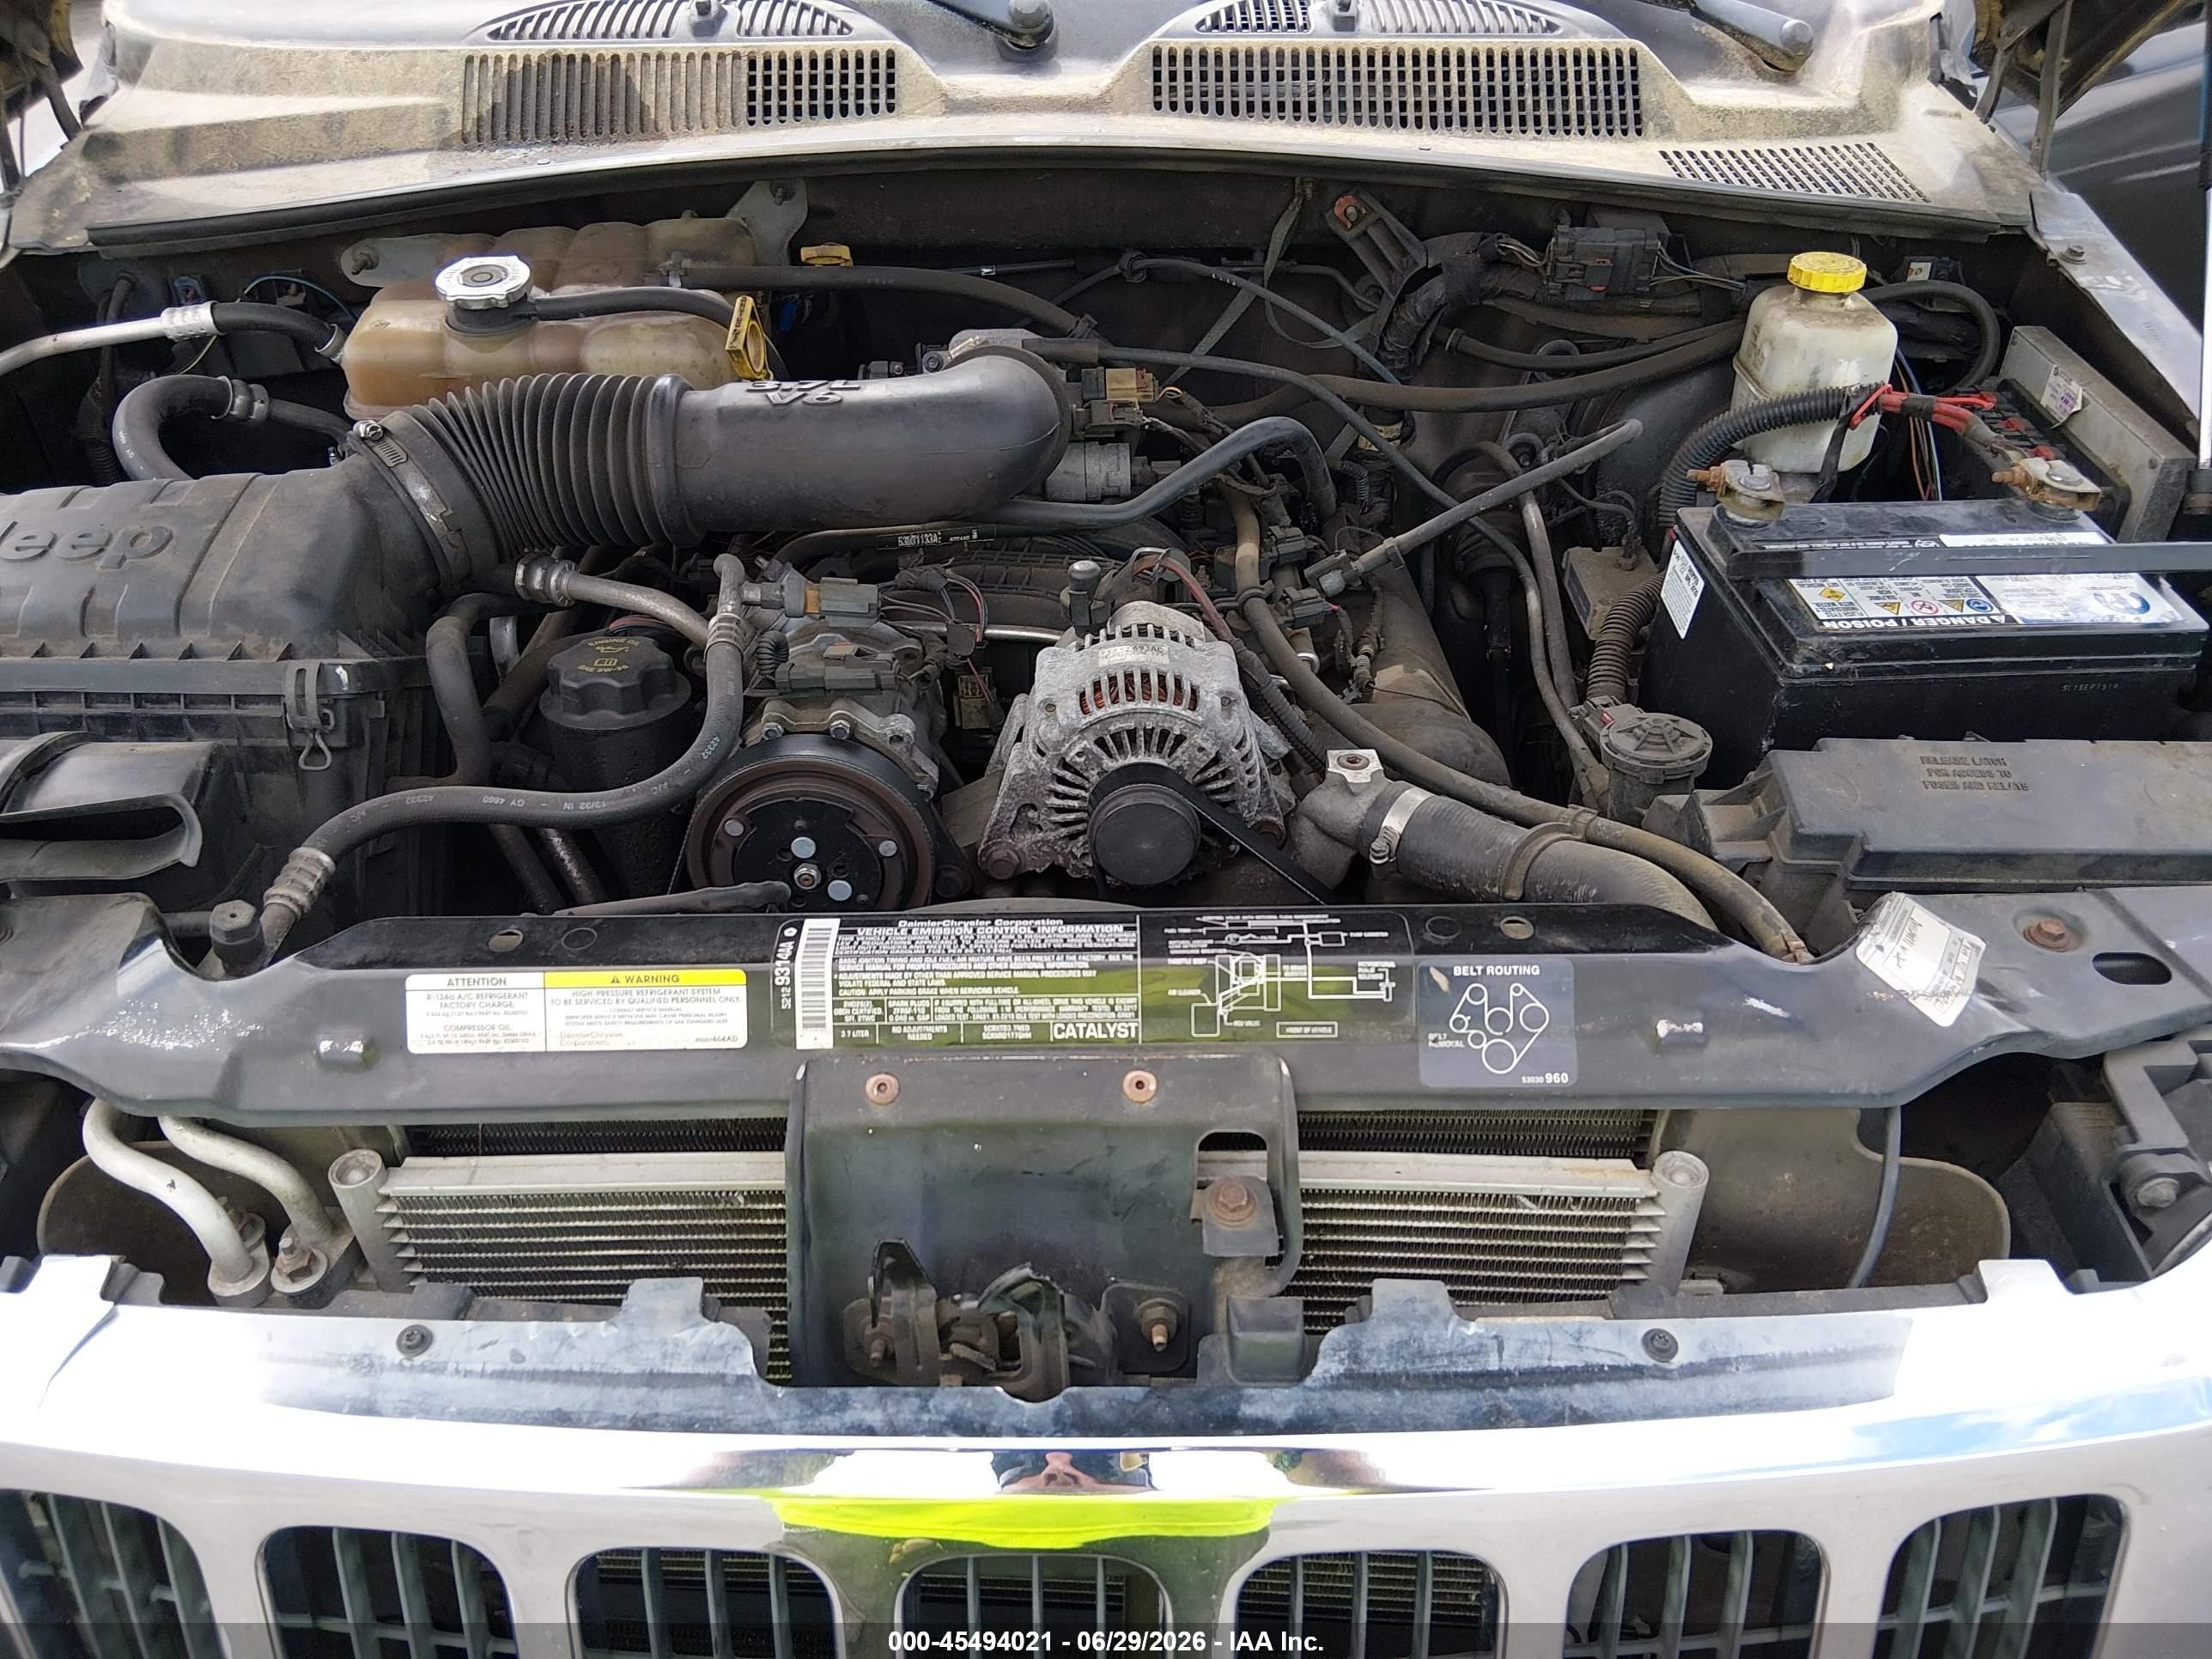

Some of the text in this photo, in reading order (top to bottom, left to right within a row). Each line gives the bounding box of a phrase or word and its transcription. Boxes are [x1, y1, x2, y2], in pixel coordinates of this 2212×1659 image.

[745, 380, 860, 392] 3.7L
[765, 392, 842, 404] V6
[1823, 618, 1899, 629] POISON
[1909, 615, 1992, 626] DANGER
[1919, 756, 1970, 766] RELEASE
[897, 918, 1064, 928] DaimlerChrysler Corporation
[857, 927, 908, 936] VEHICLE
[912, 927, 973, 935] EMISSION
[975, 926, 1034, 934] CONTROL
[1453, 964, 1540, 976] BELT ROUTING
[447, 976, 507, 987] ATTENTION
[624, 975, 680, 984] WARNING
[476, 991, 529, 1000] REFRIGERANT
[1053, 1022, 1138, 1039] CATALYST
